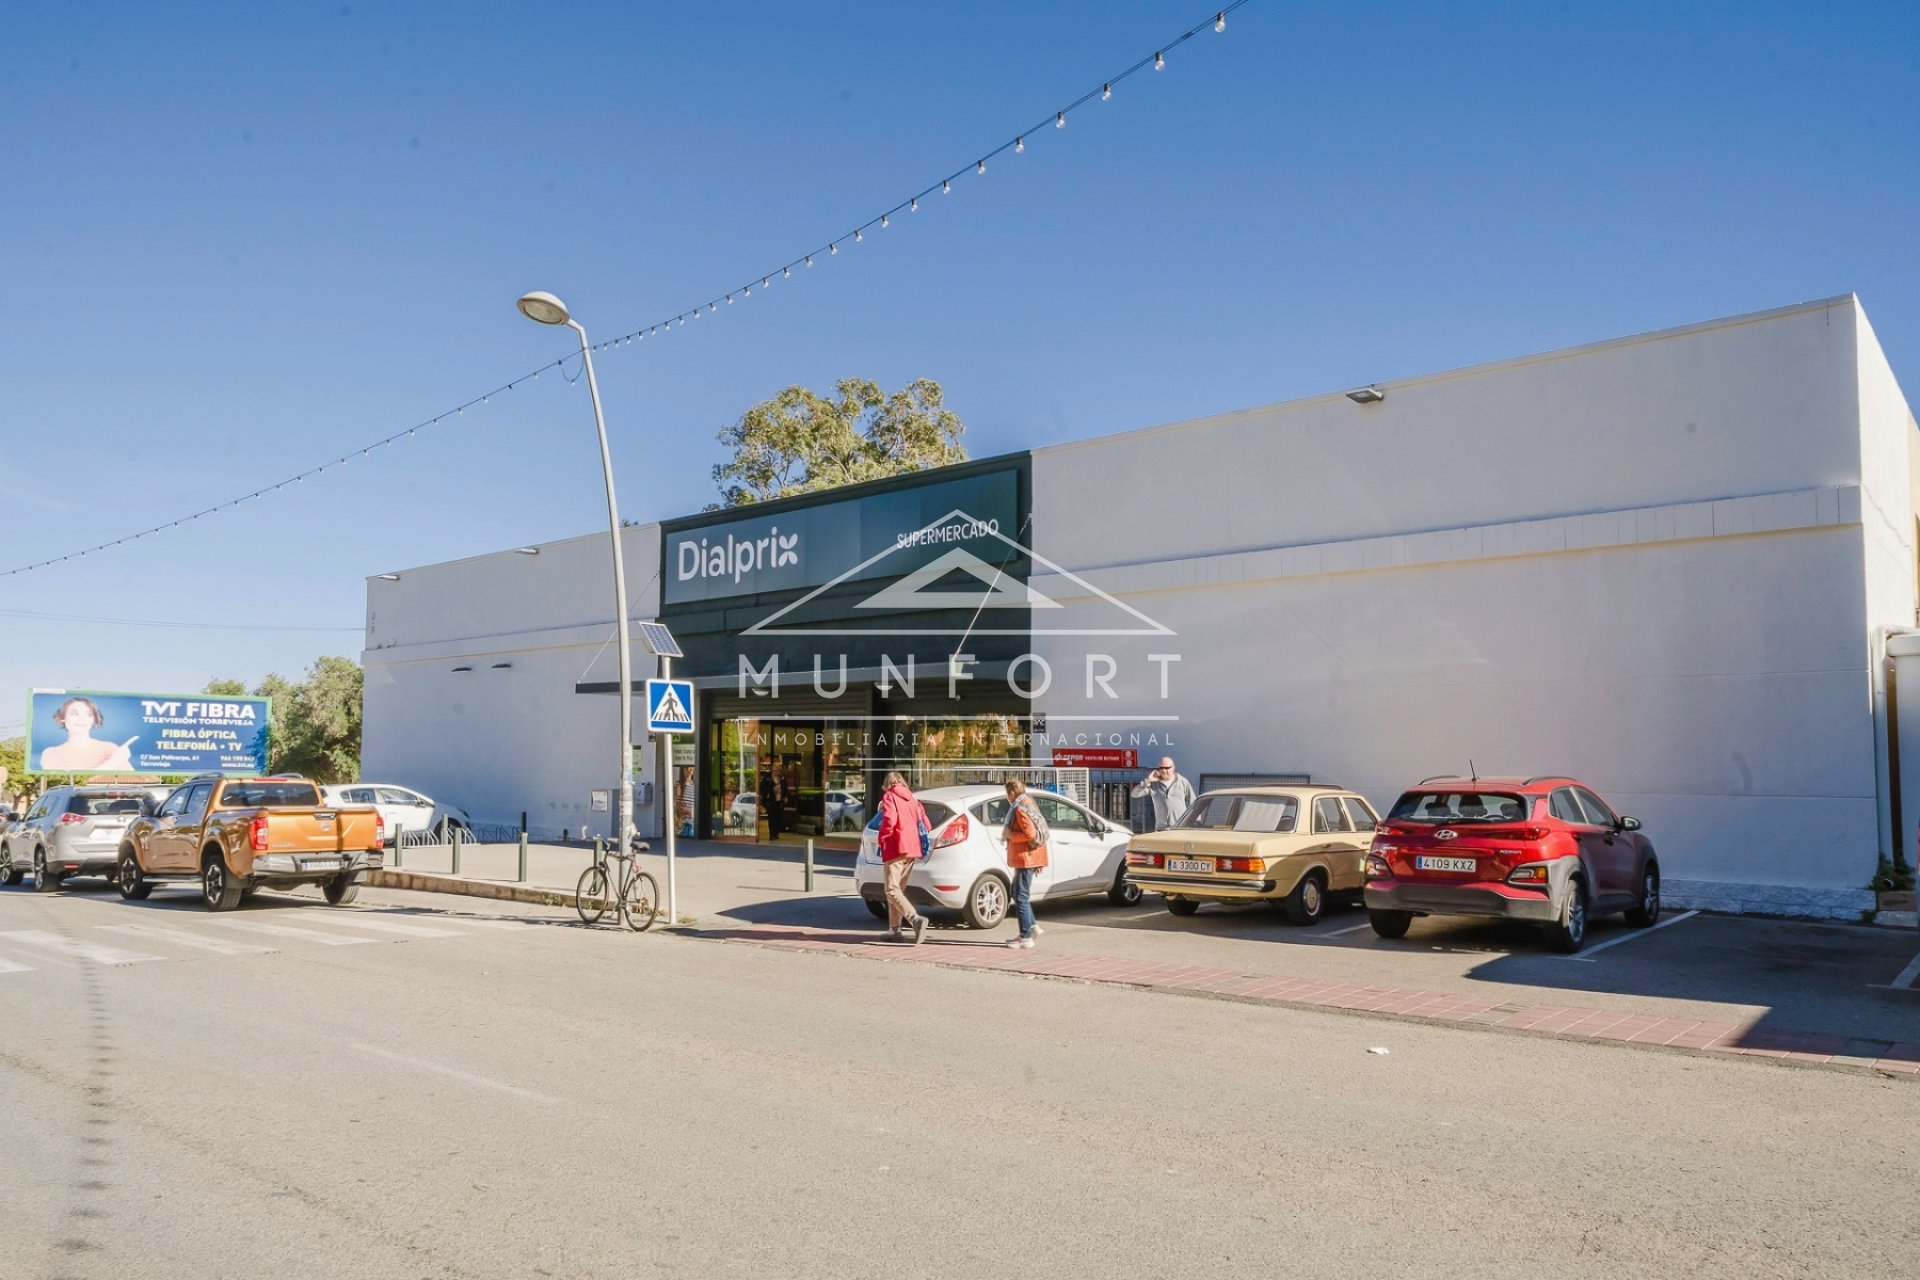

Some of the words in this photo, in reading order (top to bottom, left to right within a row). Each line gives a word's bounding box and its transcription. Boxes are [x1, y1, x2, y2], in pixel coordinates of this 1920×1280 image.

[678, 526, 799, 584] Dialprix
[896, 519, 999, 549] SUPERMERCADO
[141, 700, 182, 716] TVT
[186, 702, 256, 719] FIBRA
[142, 715, 197, 725] TELEVISIÓN
[198, 717, 254, 726] TORREVIEJA
[162, 729, 196, 738] FIBRA
[197, 727, 238, 740] ÓPTICA
[156, 740, 218, 751] TELEFONÍA
[228, 742, 242, 751] TV
[1180, 861, 1199, 871] 3300
[1423, 858, 1450, 869] 4109
[1453, 859, 1475, 871] KXZ
